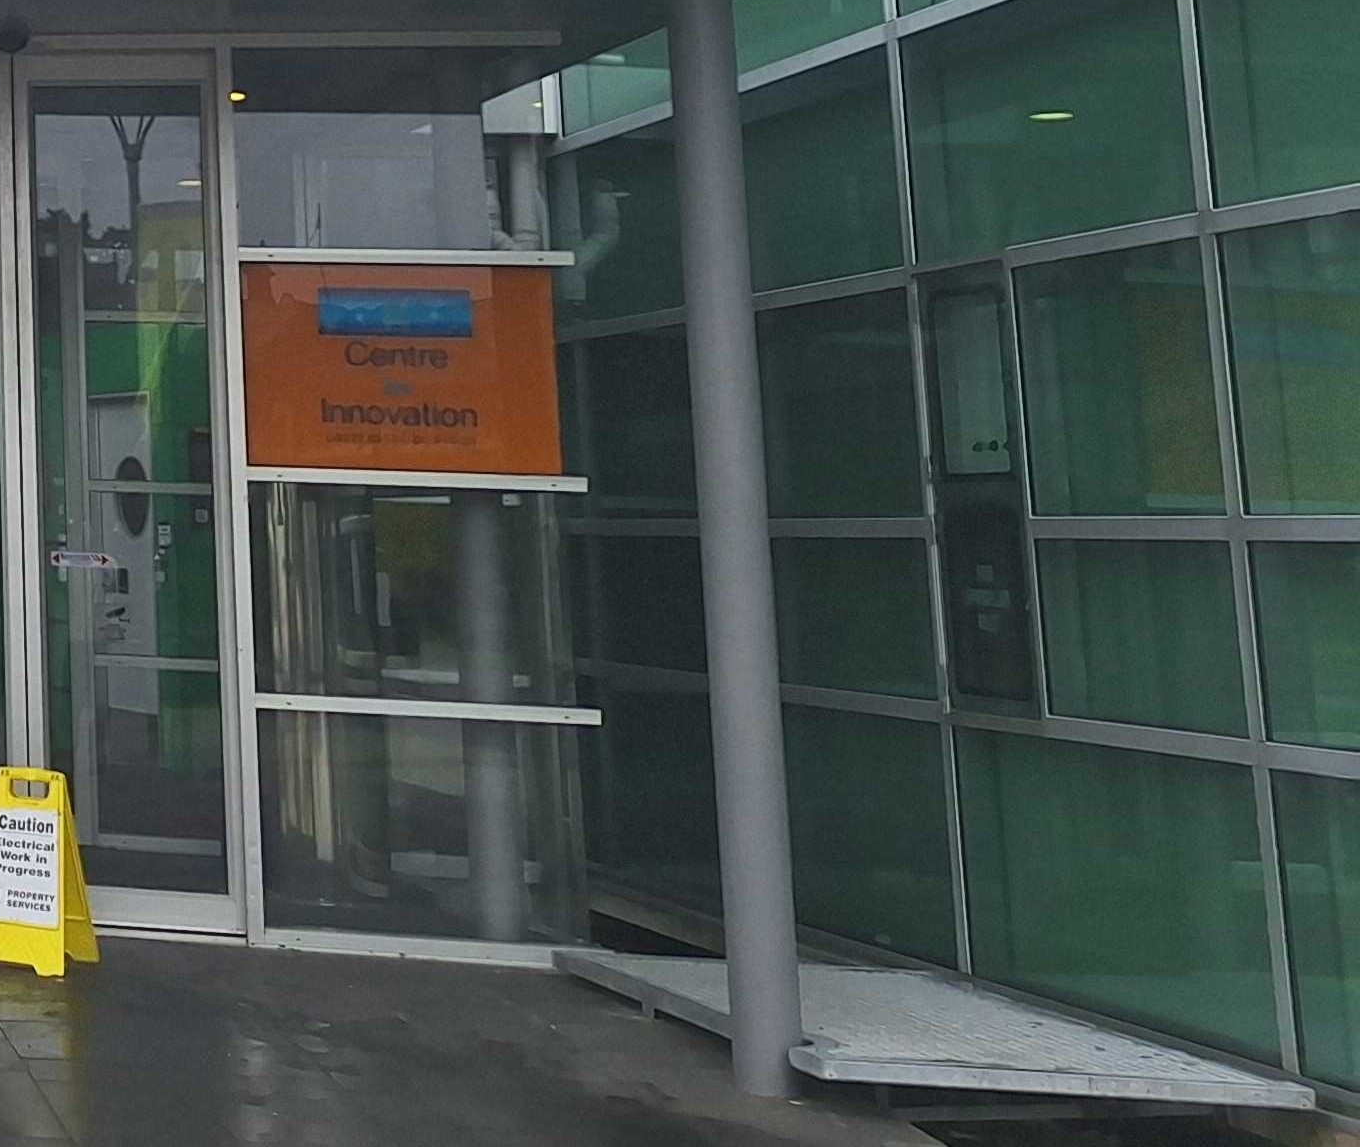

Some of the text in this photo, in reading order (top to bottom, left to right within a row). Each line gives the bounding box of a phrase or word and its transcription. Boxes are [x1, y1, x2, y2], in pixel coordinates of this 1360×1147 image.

[343, 340, 449, 369] Centre
[320, 397, 478, 428] Innovation
[0, 850, 48, 864] Work in
[7, 889, 55, 902] PROPERTY
[6, 899, 51, 912] SERVICES
